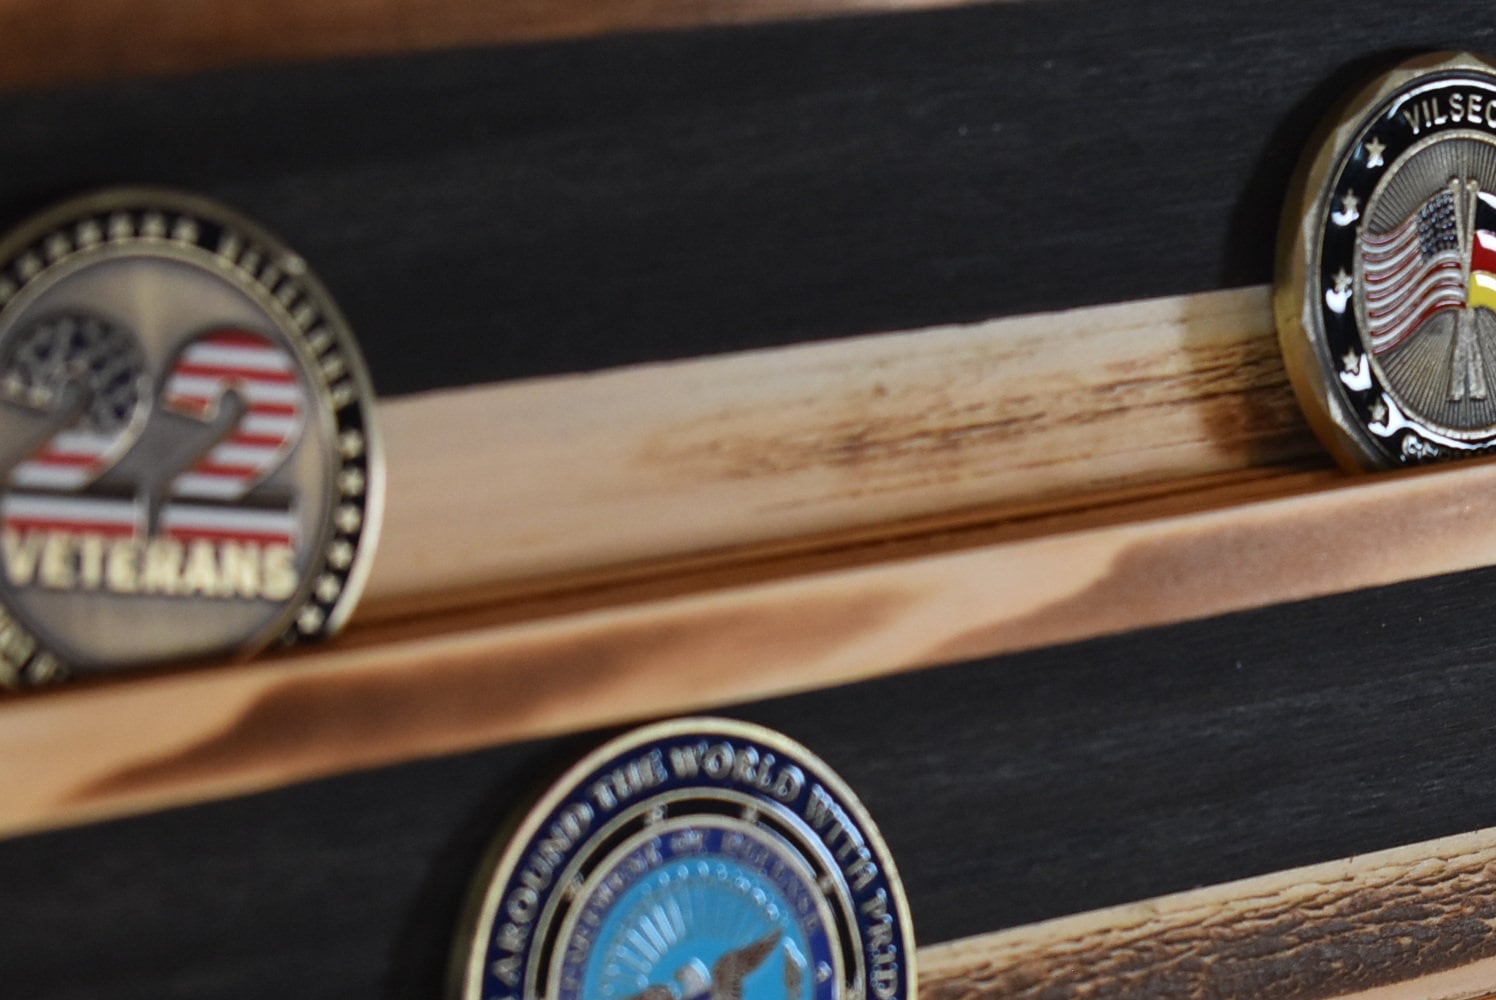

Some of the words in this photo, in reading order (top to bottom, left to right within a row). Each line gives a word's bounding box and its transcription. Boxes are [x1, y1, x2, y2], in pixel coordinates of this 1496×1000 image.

[2, 528, 298, 600] VETERANS
[492, 801, 594, 987] AROUND
[592, 748, 668, 810] THE
[668, 740, 806, 802] WORLD
[804, 782, 880, 902] WITH
